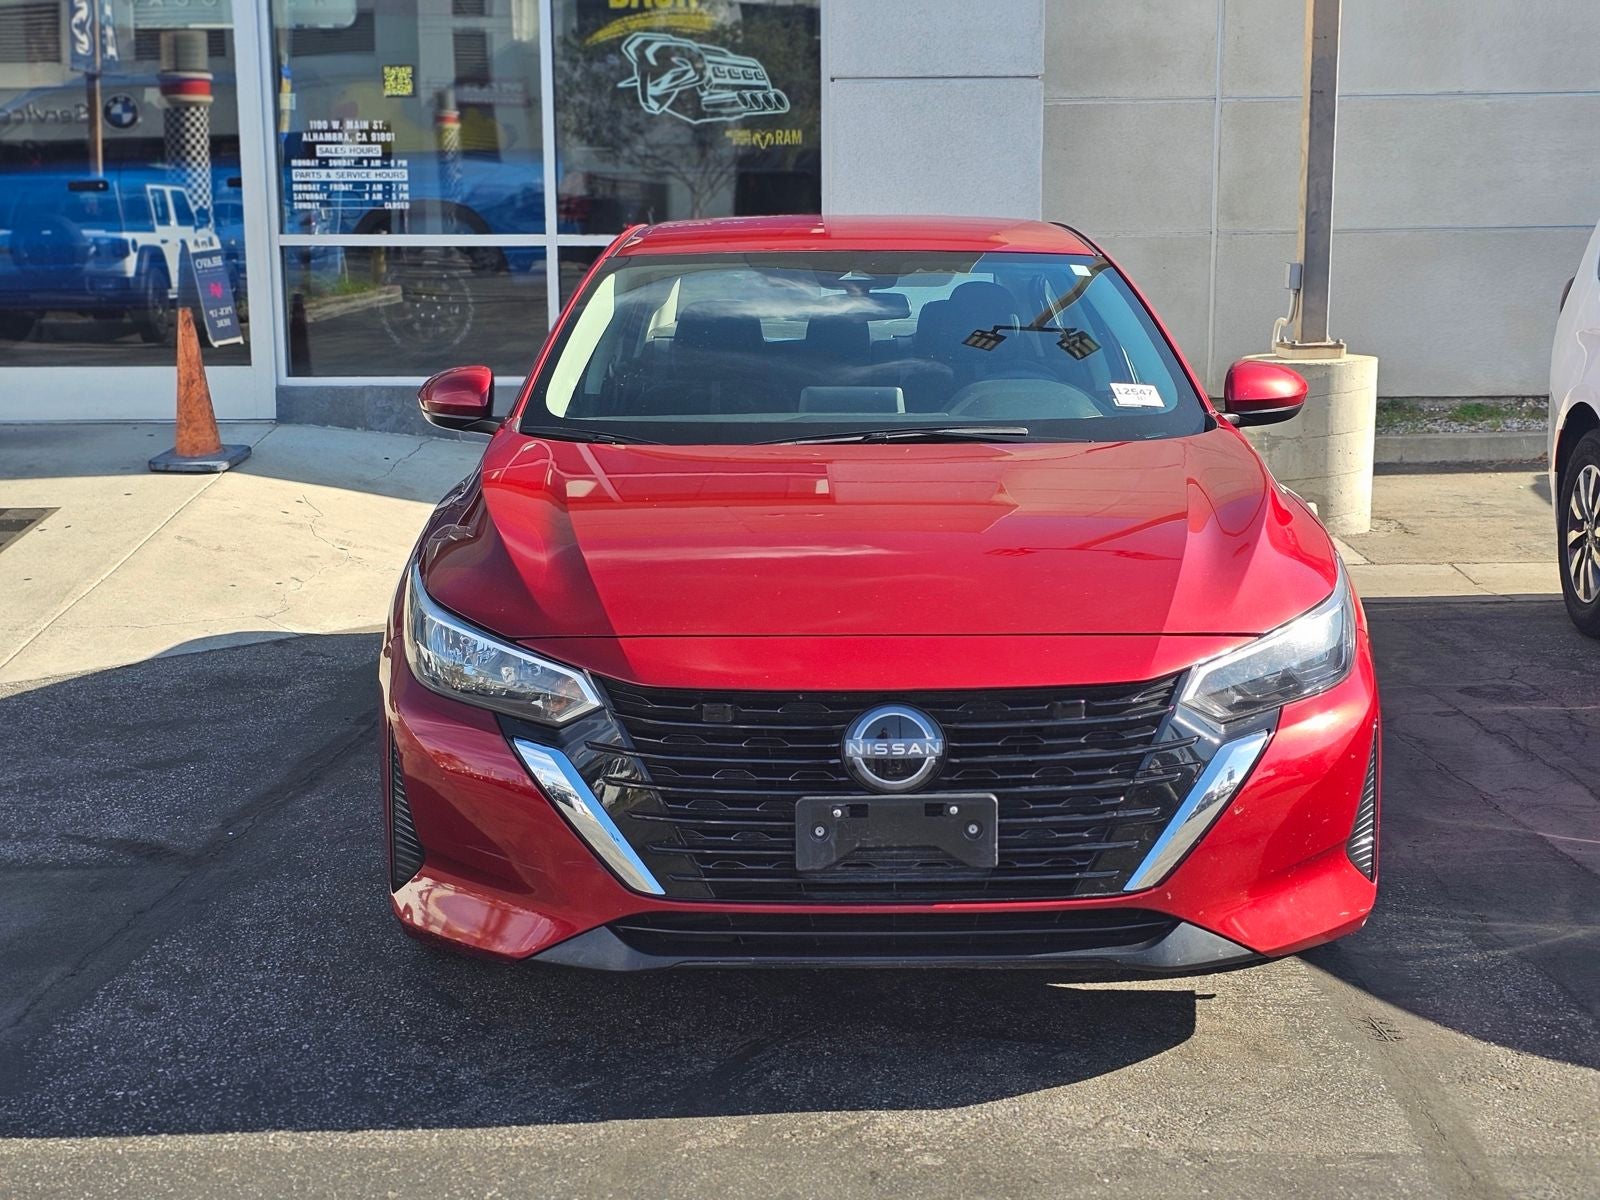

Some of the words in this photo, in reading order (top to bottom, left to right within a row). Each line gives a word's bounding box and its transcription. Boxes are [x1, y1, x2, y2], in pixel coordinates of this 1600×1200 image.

[331, 120, 343, 130] W.
[346, 120, 369, 130] MAIN
[372, 120, 387, 130] ST.
[302, 132, 353, 143] ALHAMBRA,
[356, 132, 368, 142] CA
[775, 129, 802, 145] RAM
[318, 146, 346, 155] SALES
[349, 146, 380, 155] HOURS
[294, 171, 322, 179] PARTS
[326, 171, 332, 179] &
[335, 171, 371, 179] SERVICE
[375, 171, 405, 179] HOURS
[848, 742, 940, 755] NISSAN
